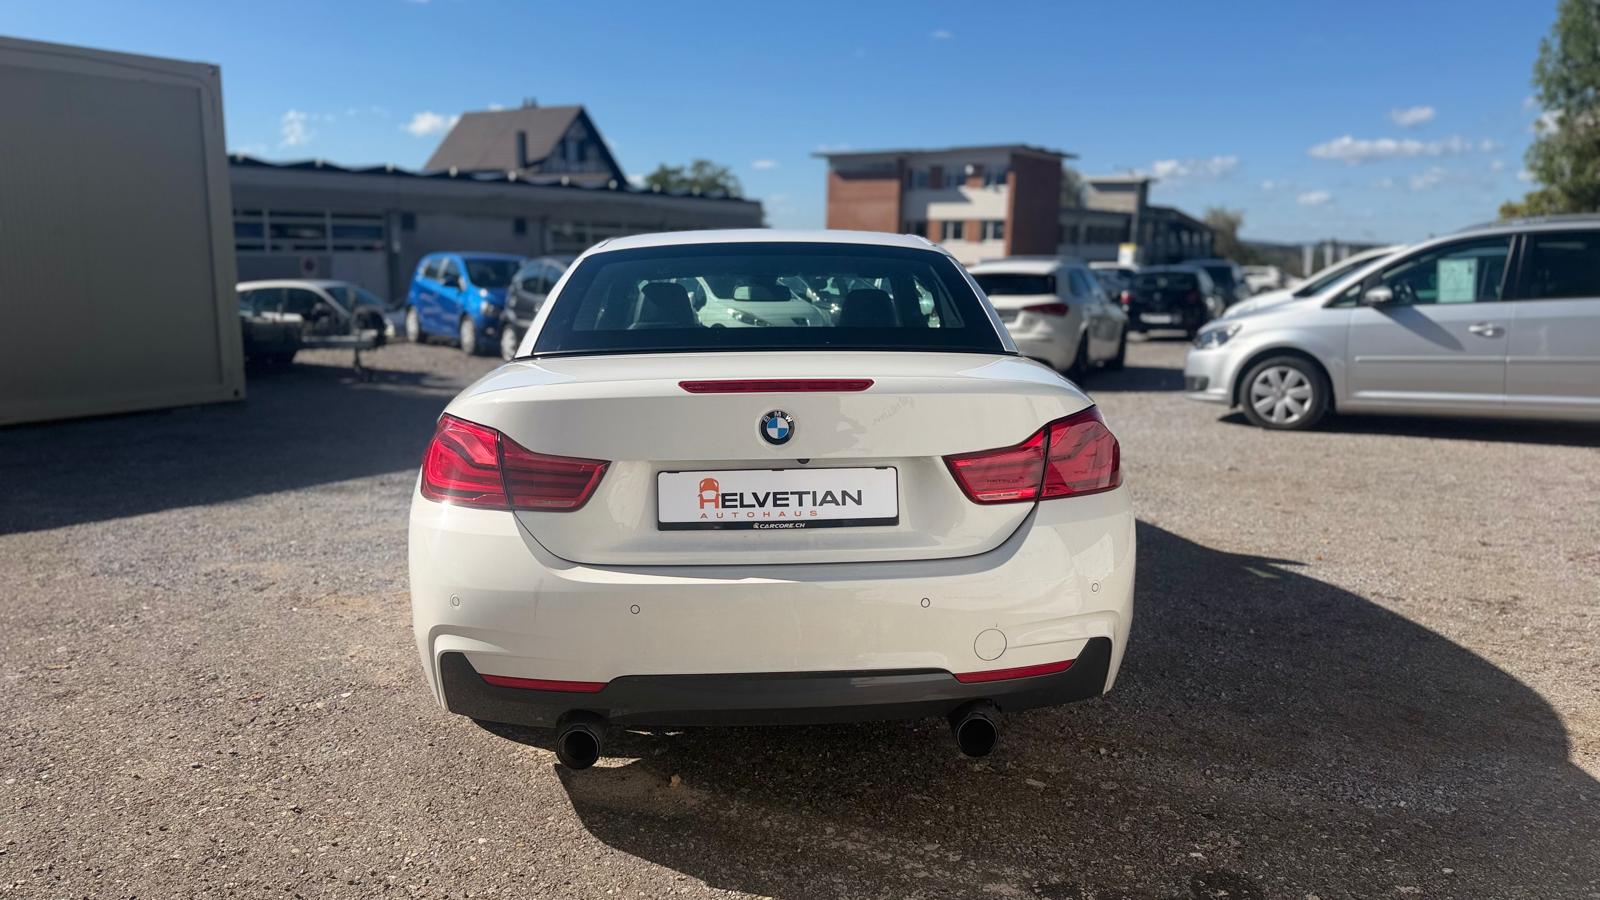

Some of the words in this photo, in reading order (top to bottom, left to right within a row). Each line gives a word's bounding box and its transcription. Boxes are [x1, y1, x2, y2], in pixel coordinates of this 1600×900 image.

[763, 411, 794, 423] BMW
[699, 479, 862, 509] HELVETIAN
[700, 510, 818, 519] AUTOHAUS
